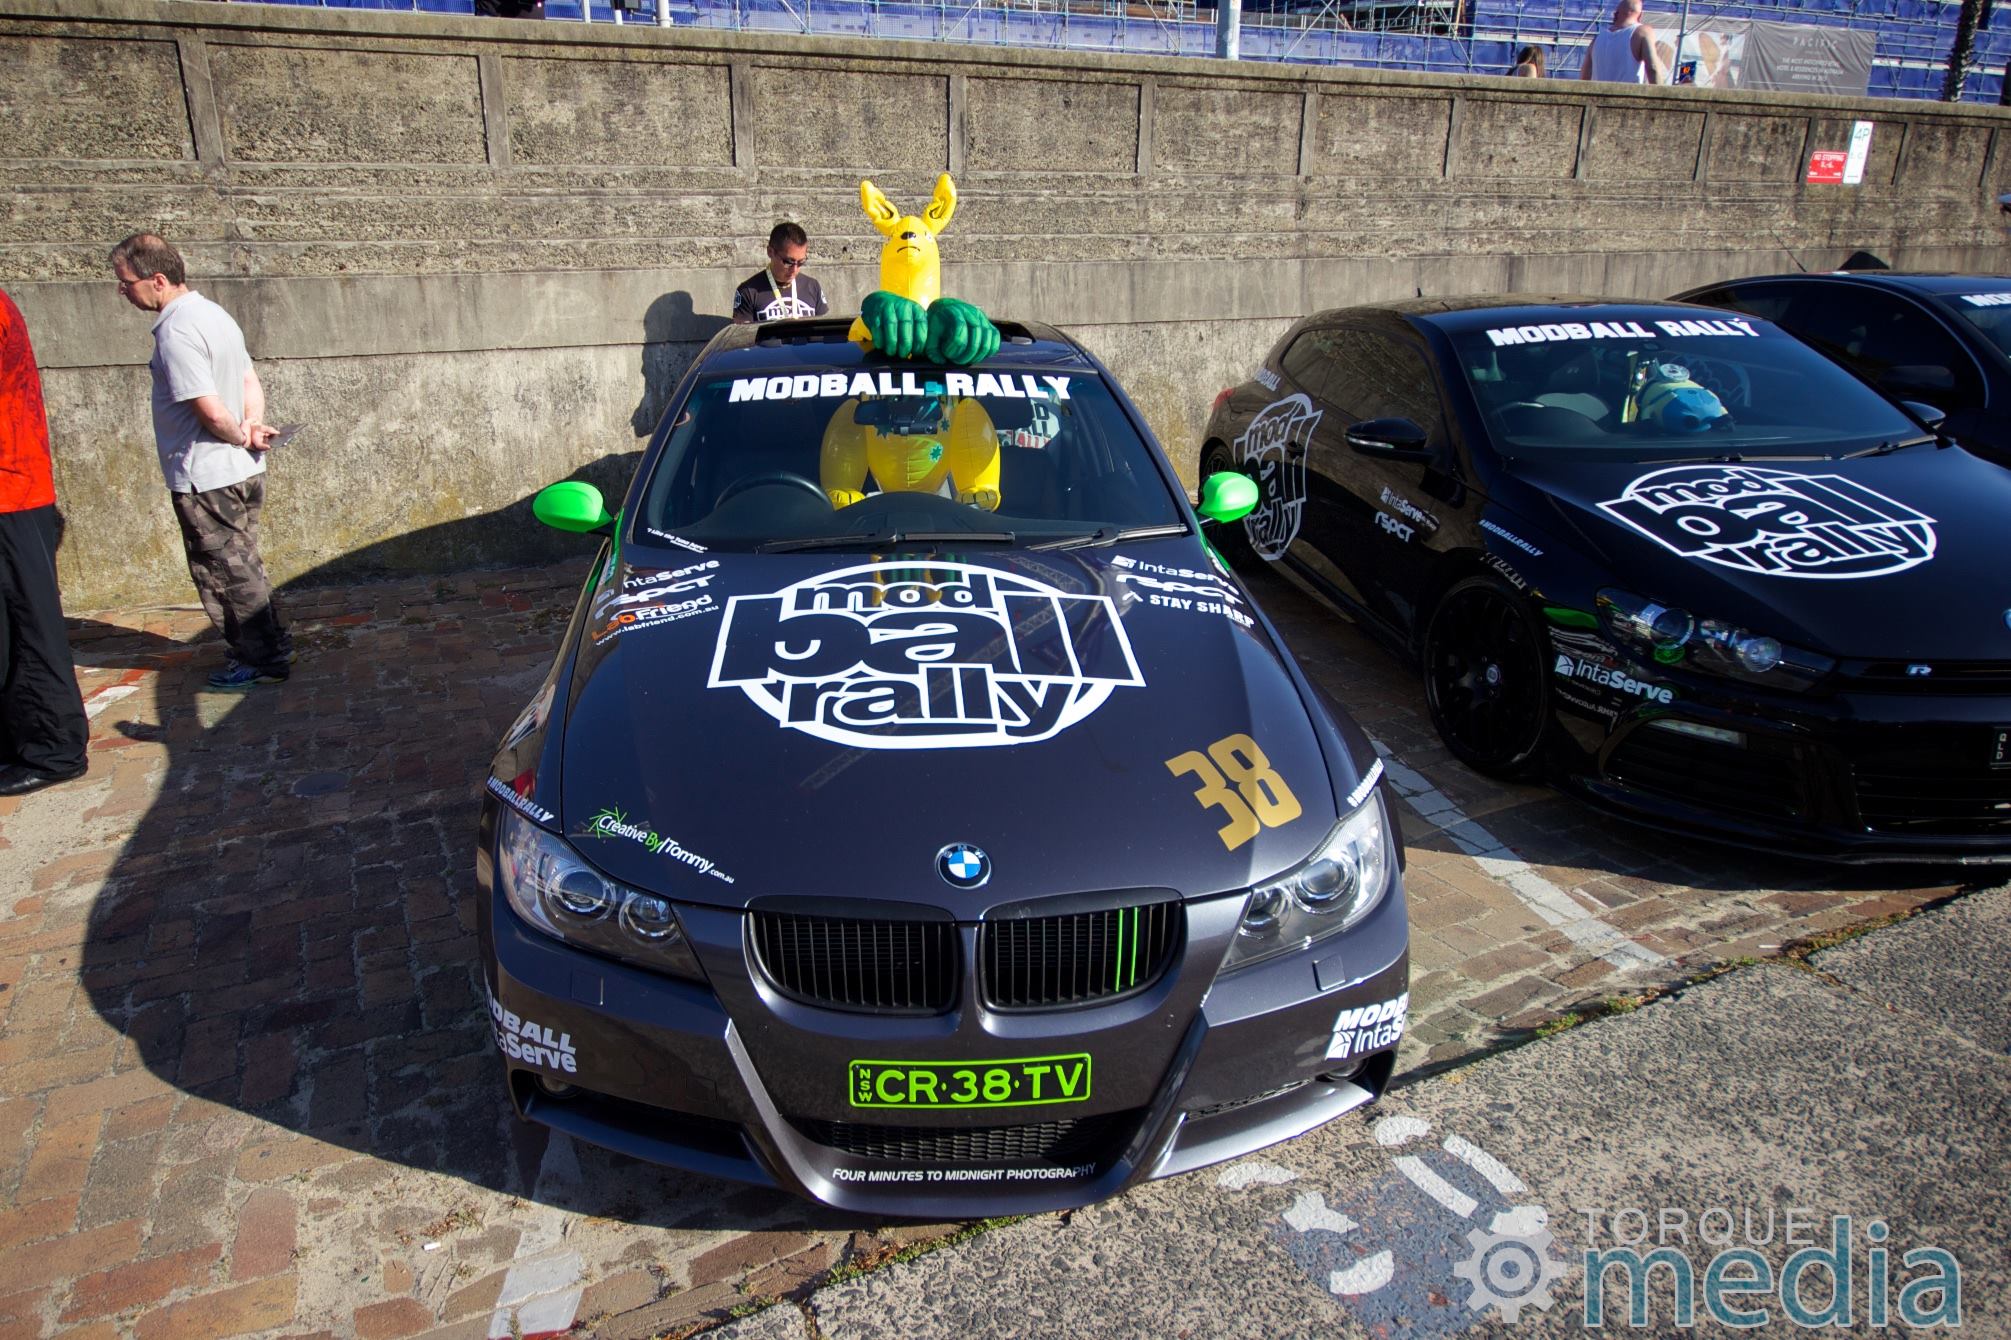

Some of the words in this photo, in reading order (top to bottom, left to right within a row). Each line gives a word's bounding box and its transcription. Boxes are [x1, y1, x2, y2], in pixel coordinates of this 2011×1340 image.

[1486, 321, 1656, 346] MODBALL
[1654, 319, 1760, 337] RALLY
[728, 372, 925, 402] MODBALL
[945, 372, 1071, 400] RALLY
[787, 569, 998, 612] mod
[1139, 561, 1240, 595] IntaServe
[596, 605, 720, 646] www.labfriend.com.au
[1150, 595, 1192, 610] STAY
[1197, 602, 1255, 629] SHARP
[706, 592, 1147, 688] ball
[1576, 657, 1673, 704] IntaServe
[780, 663, 1090, 740] rally
[1164, 733, 1302, 851] 38
[598, 815, 648, 843] Creative
[858, 1068, 873, 1103] NSW
[832, 1168, 866, 1182] FOUR
[868, 1170, 924, 1182] MINUTES
[926, 1171, 943, 1181] TO
[944, 1169, 1004, 1181] MIDNIGHT
[1006, 1162, 1097, 1181] PHOTOGRAPHY
